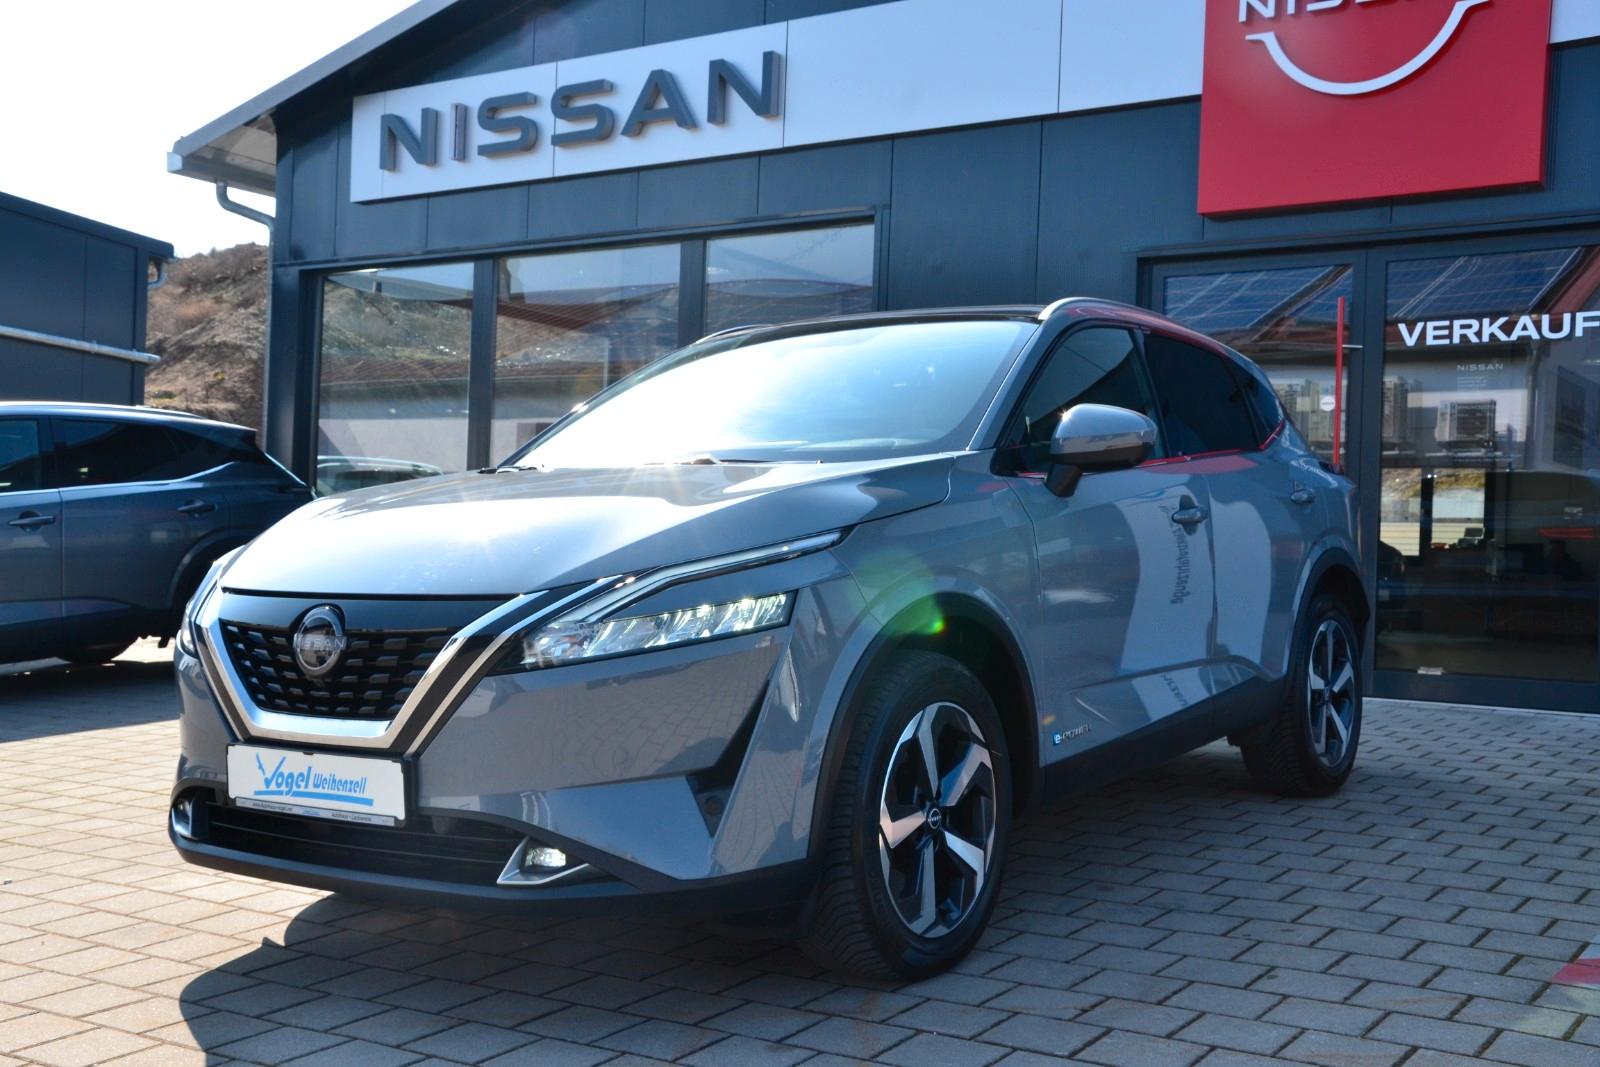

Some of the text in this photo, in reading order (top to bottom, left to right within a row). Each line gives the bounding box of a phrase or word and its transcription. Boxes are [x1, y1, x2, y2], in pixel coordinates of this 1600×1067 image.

[379, 50, 781, 172] NISSAN
[1398, 310, 1600, 347] VERKAUF
[1456, 363, 1504, 371] NISSAN
[256, 752, 367, 795] Vogel Weihenzell
